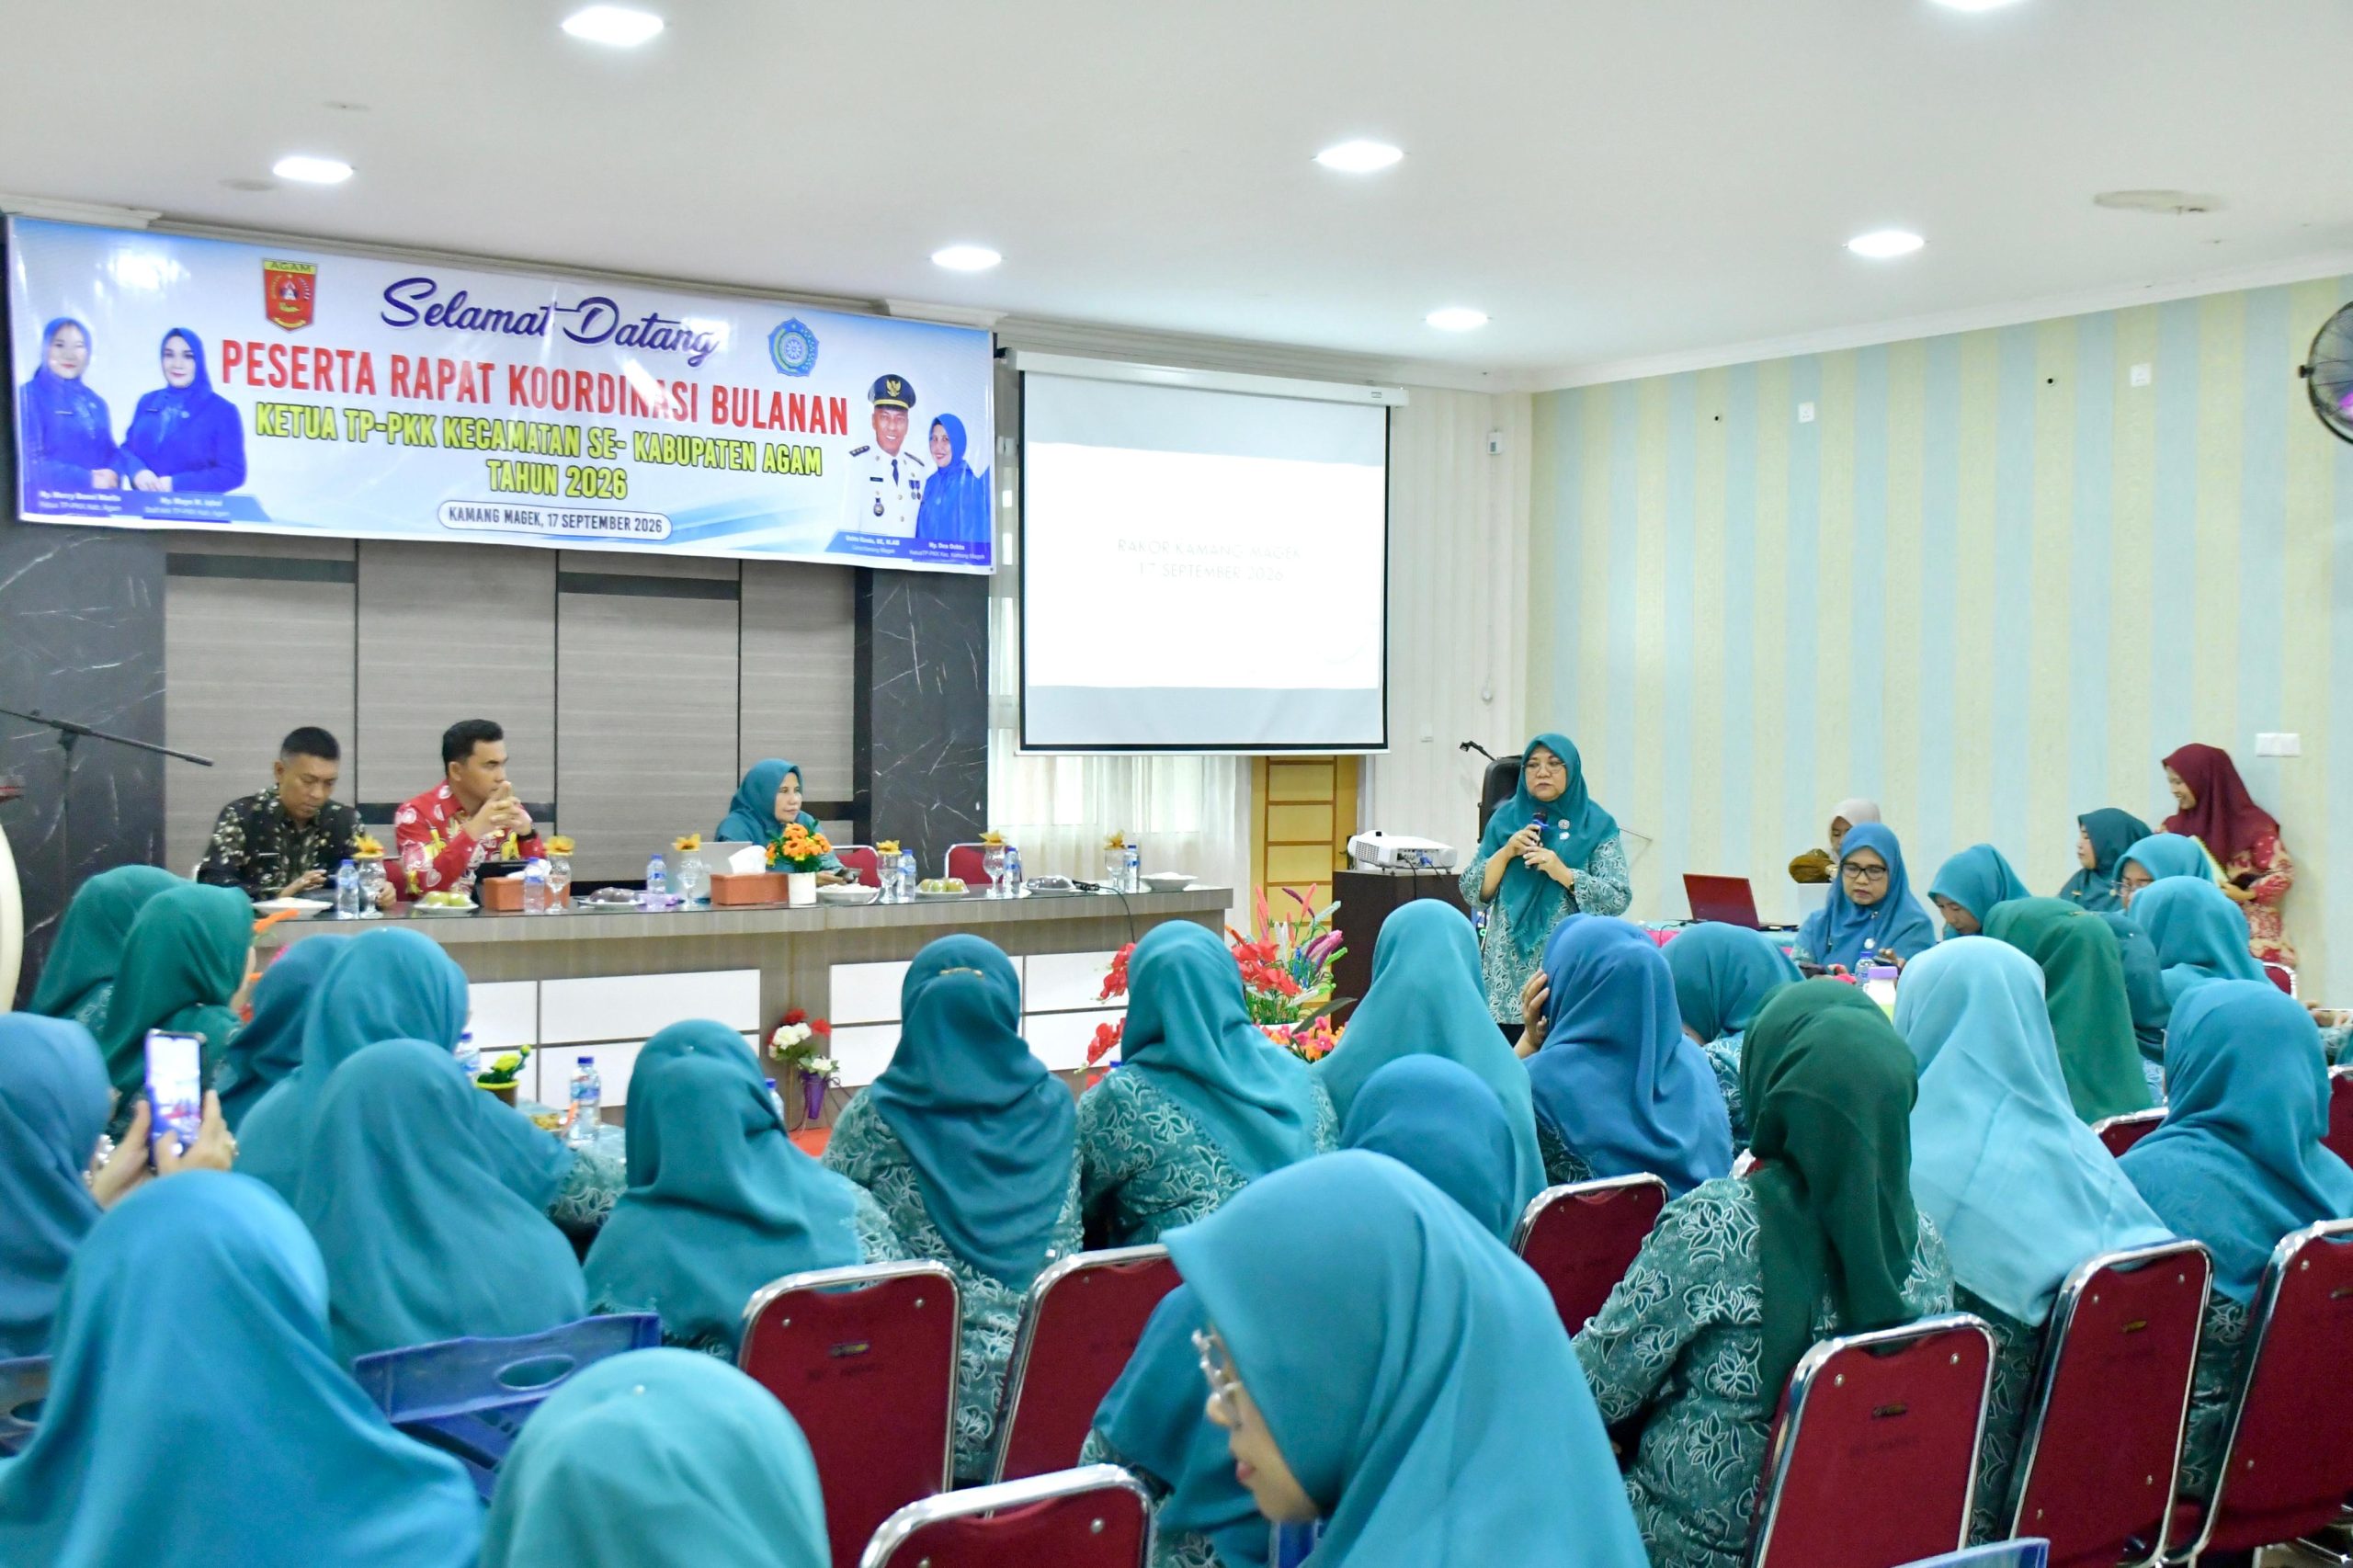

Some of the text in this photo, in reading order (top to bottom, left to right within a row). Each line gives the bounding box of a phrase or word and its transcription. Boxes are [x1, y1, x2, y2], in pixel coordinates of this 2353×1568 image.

[381, 278, 720, 368] Selamat Datang
[222, 339, 848, 436] PESERTA RAPAT KOORDINASI BULANAN
[256, 402, 337, 441] KETUA
[343, 407, 437, 448] TP-PKK
[443, 415, 581, 458] KECAMATAN
[632, 431, 756, 472] KABUPATEN
[762, 443, 824, 476] AGAM
[486, 459, 628, 500] TAHUN 2026
[449, 506, 663, 533] KAMANG MAGEK, 17 SEPTEMBER 2026
[1118, 539, 1170, 555] RAKOR
[1176, 543, 1243, 559] KAMANG
[1162, 563, 1240, 579] SEPTEMBER
